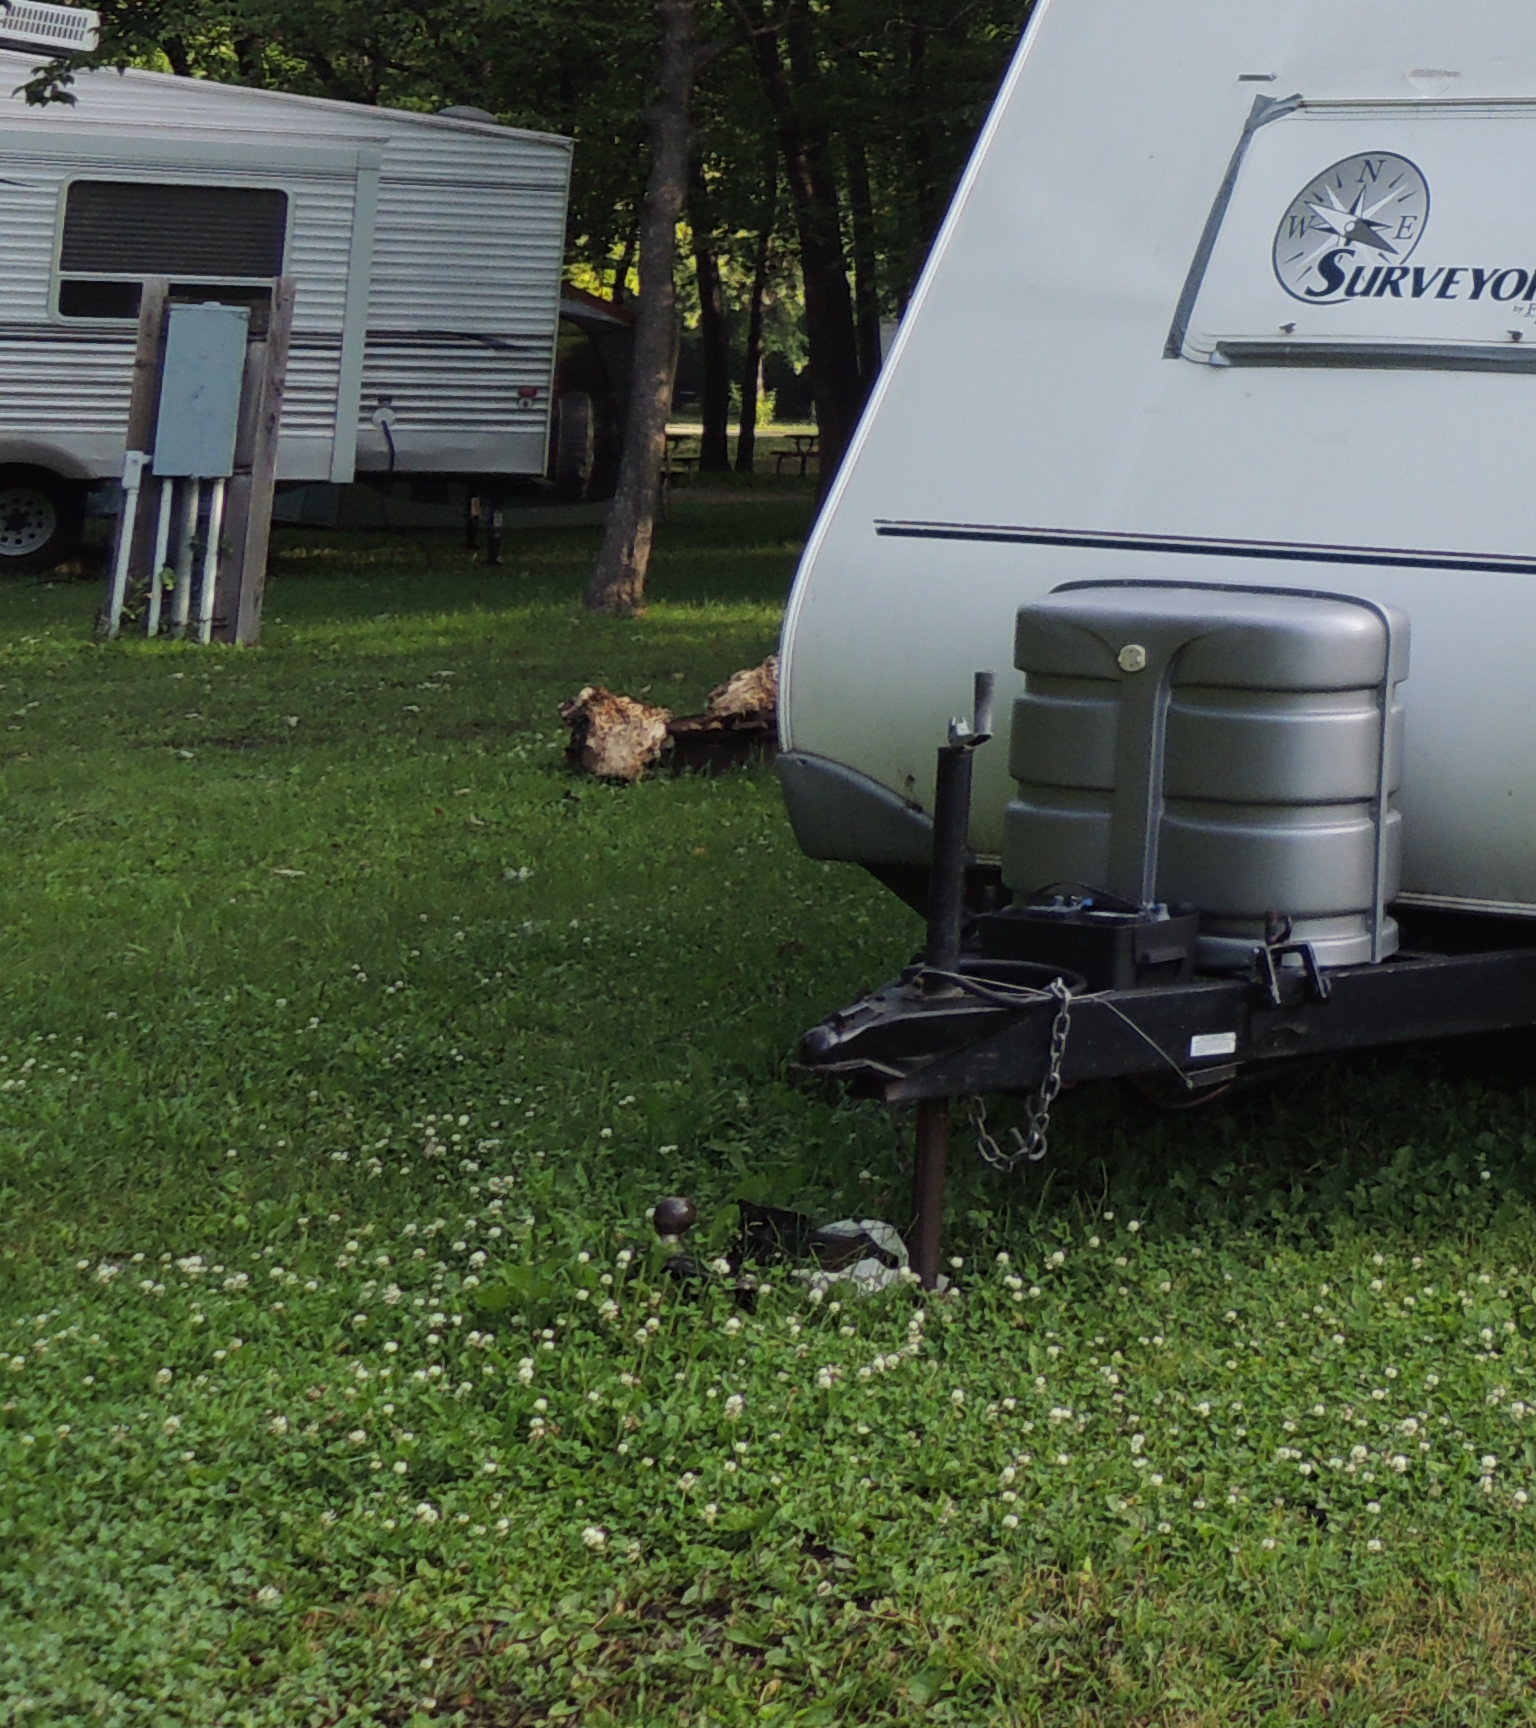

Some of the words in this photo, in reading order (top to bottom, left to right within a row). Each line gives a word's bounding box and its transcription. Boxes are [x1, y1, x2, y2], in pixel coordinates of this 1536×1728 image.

[1357, 159, 1386, 184] N
[1288, 215, 1316, 240] W
[1392, 215, 1418, 240] E
